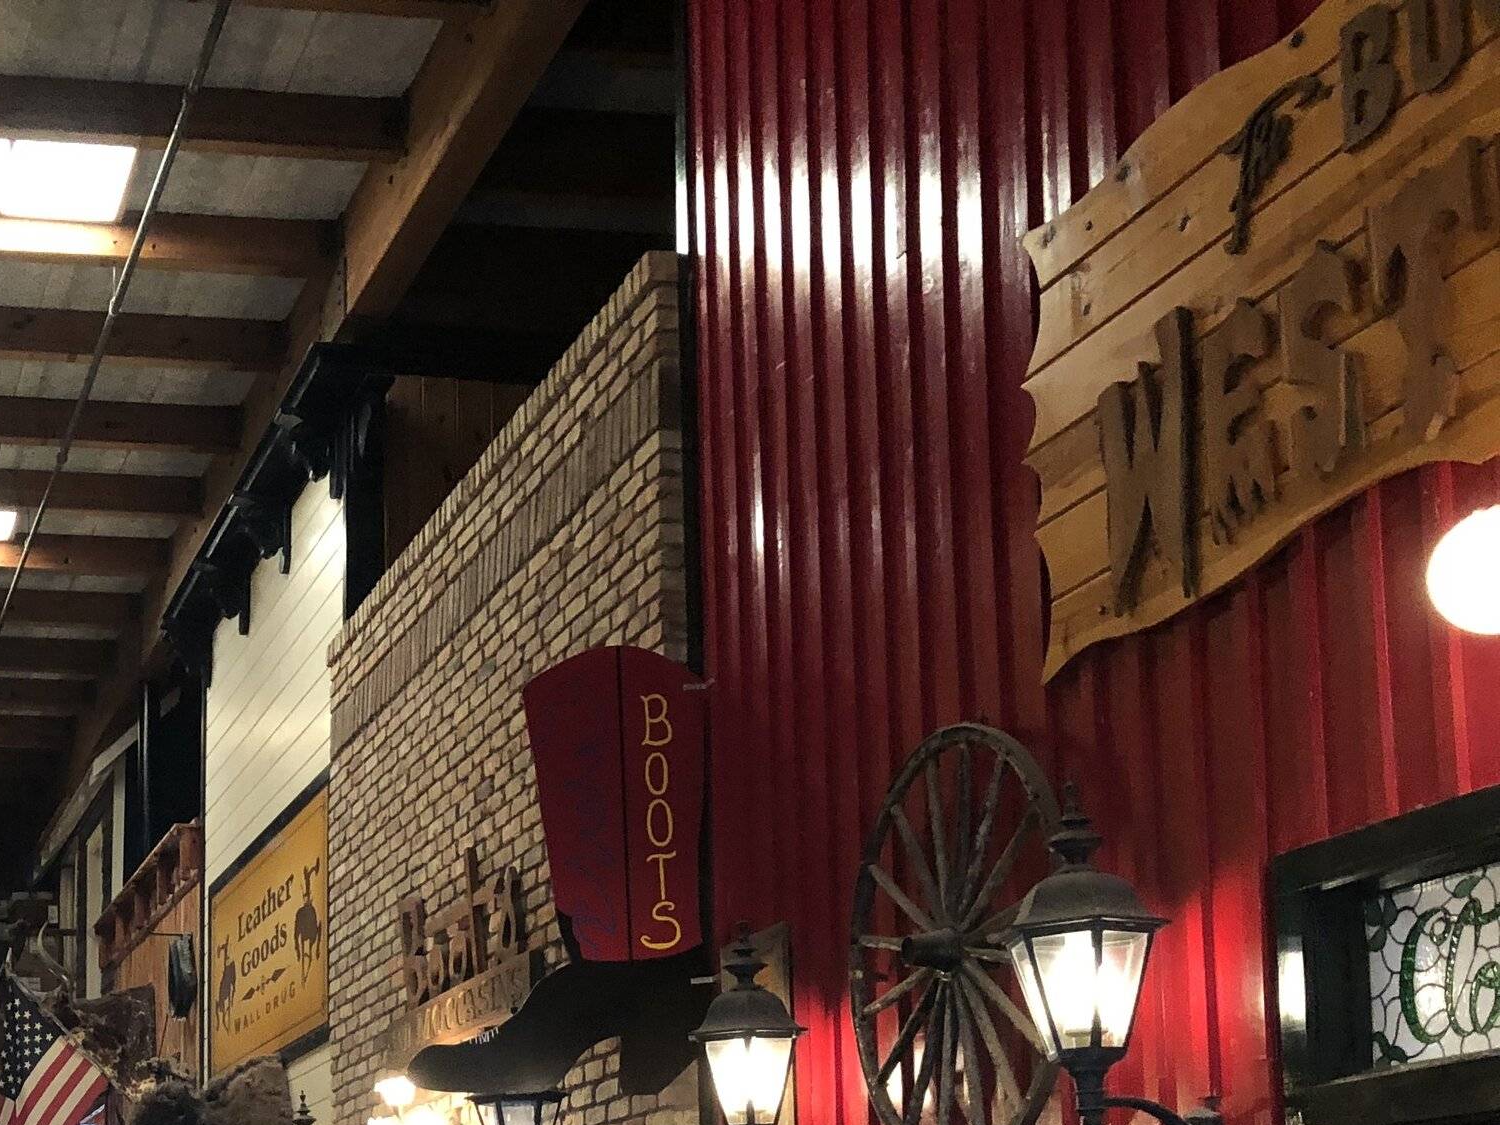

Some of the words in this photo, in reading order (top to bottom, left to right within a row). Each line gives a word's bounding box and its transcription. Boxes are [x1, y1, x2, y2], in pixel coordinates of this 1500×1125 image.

[639, 692, 683, 951] BOOTS
[237, 873, 295, 943] Leather
[240, 922, 288, 978] Goods
[233, 1008, 261, 1035] WALL
[265, 980, 296, 1015] DRUG
